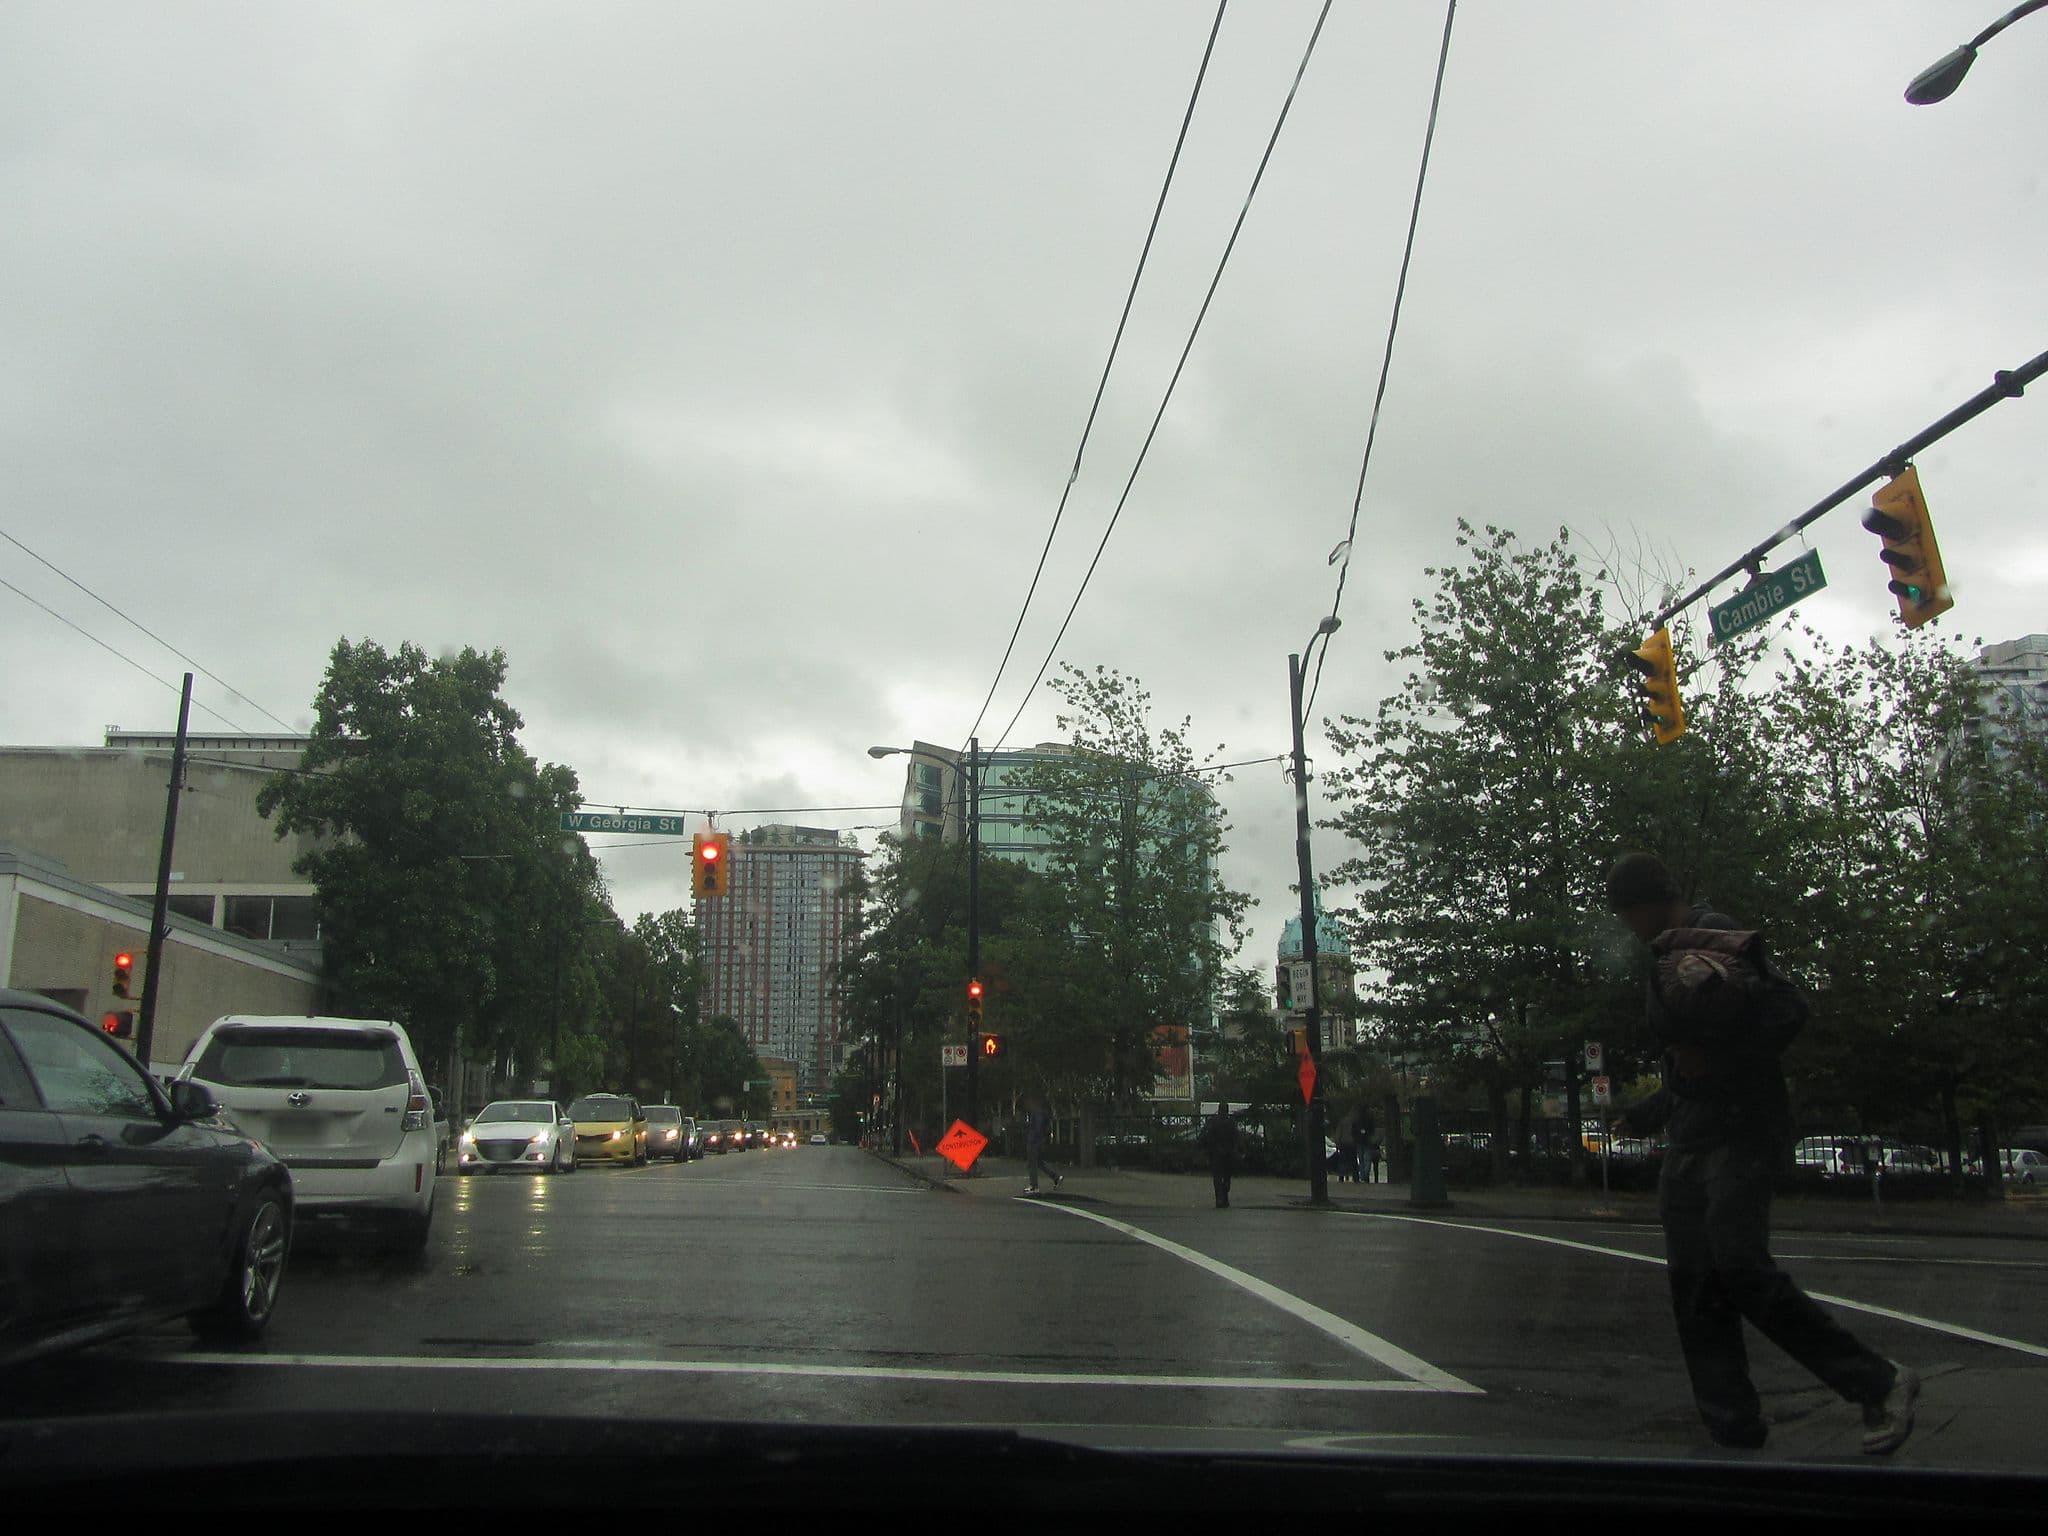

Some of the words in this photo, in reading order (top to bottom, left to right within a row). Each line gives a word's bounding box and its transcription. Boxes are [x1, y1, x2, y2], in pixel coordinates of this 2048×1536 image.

[1718, 585, 1785, 633] Cambie
[1791, 563, 1815, 592] St
[569, 815, 583, 827] W
[590, 816, 651, 831] Georgia
[659, 817, 676, 831] St
[1296, 981, 1306, 992] ONE
